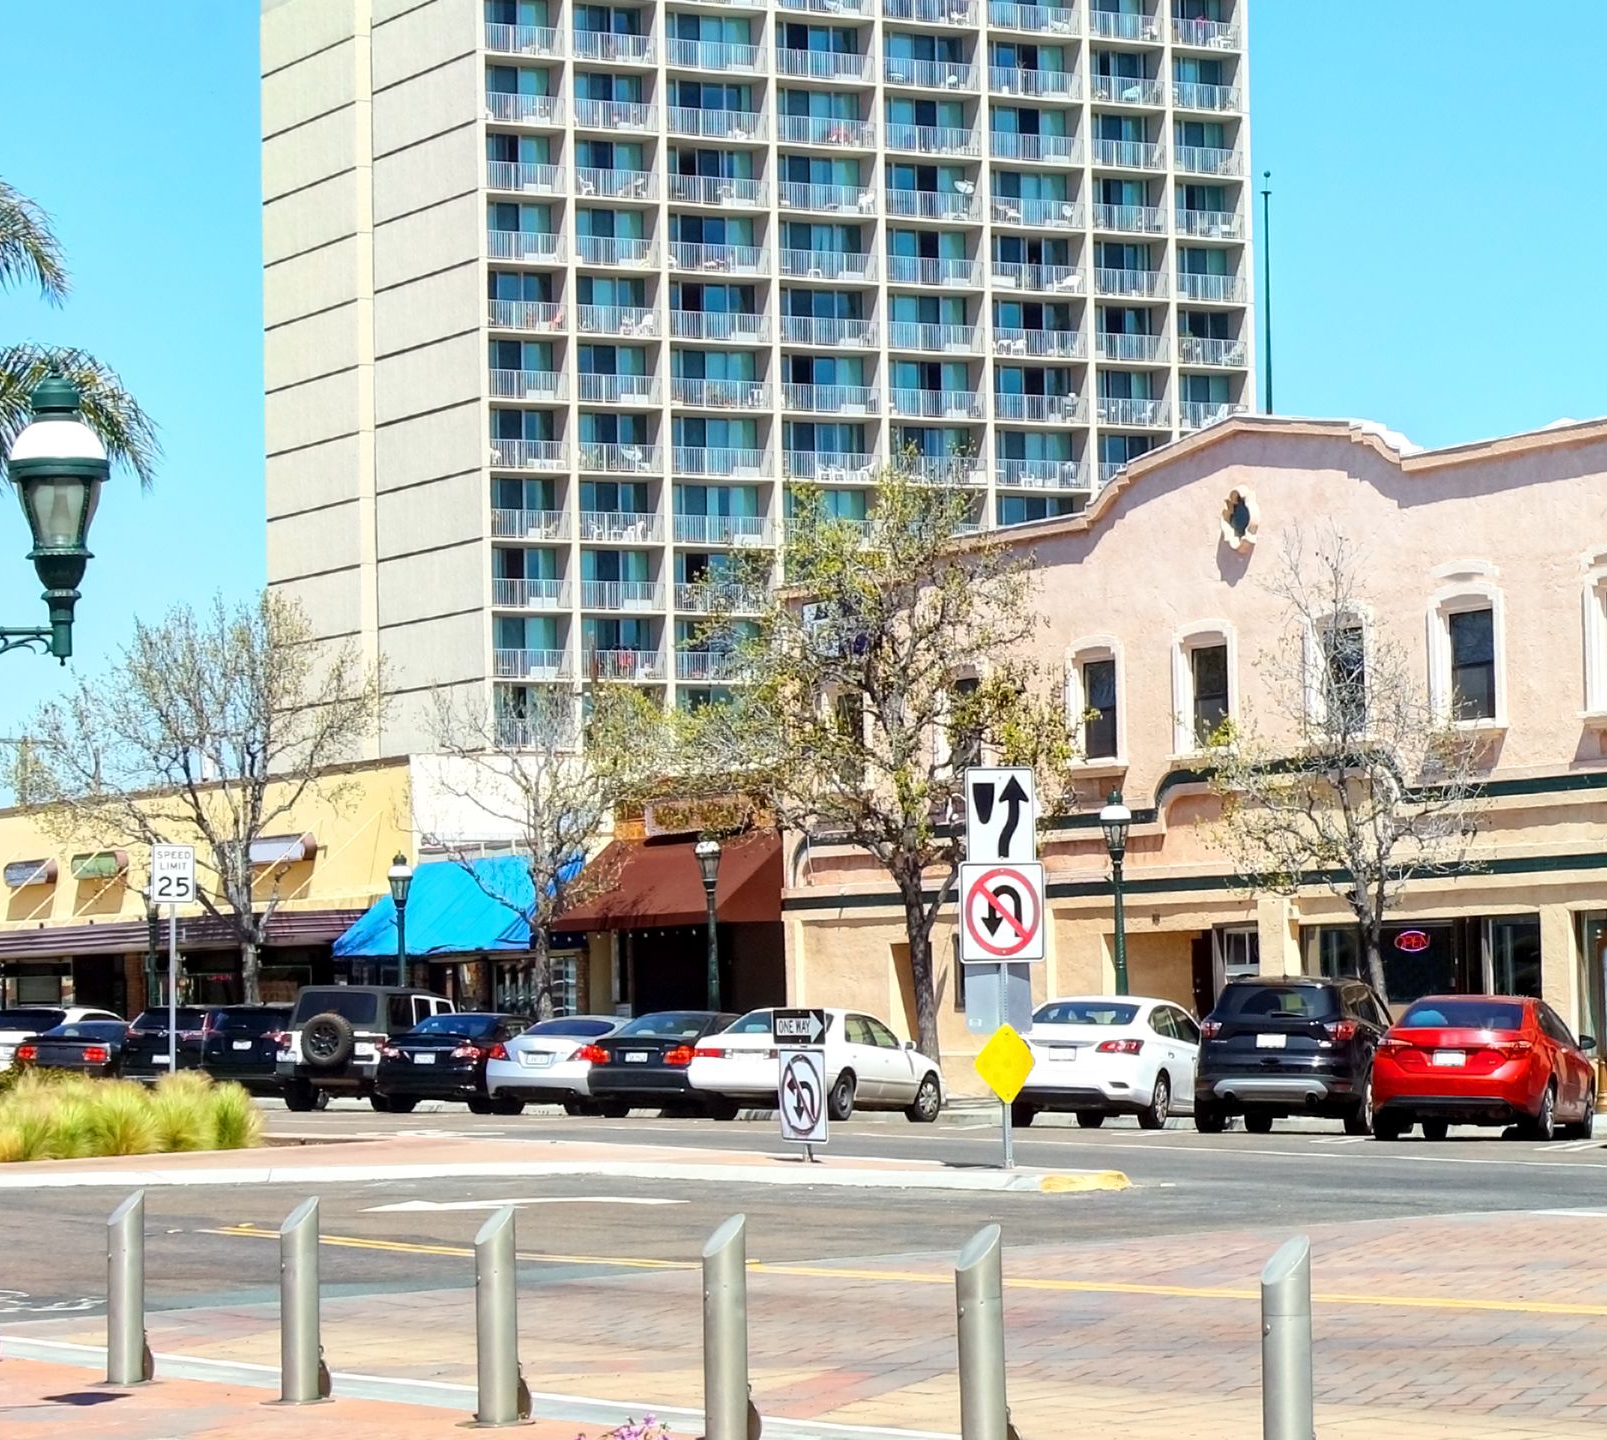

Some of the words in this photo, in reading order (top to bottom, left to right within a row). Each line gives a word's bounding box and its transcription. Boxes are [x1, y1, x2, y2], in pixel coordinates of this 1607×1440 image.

[157, 851, 191, 859] SPEED
[160, 862, 186, 870] LIMIT
[158, 876, 189, 896] 25
[1395, 935, 1430, 948] OPEN
[779, 1020, 793, 1033] ONE
[796, 1020, 810, 1033] WAY
